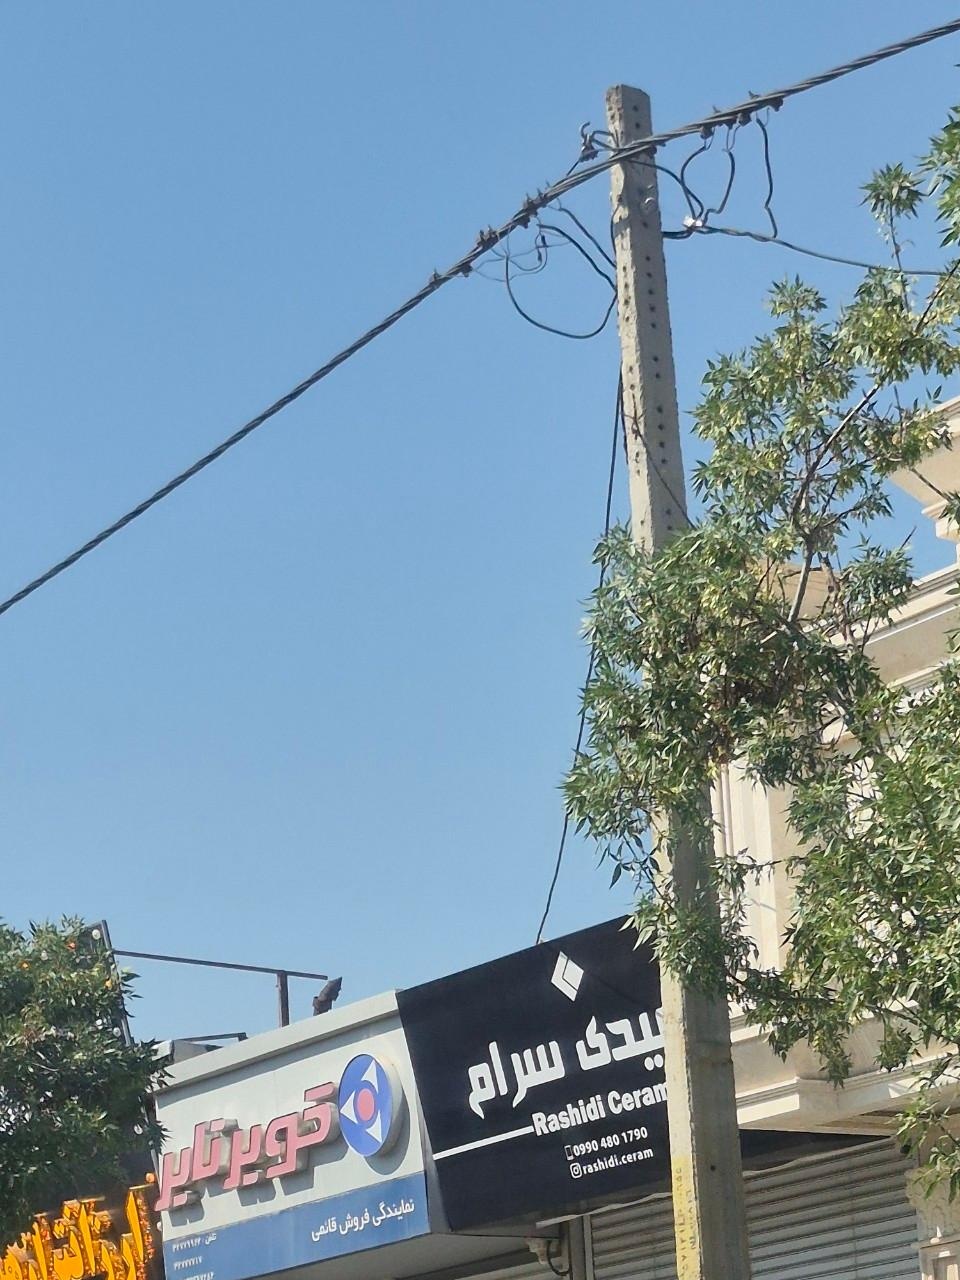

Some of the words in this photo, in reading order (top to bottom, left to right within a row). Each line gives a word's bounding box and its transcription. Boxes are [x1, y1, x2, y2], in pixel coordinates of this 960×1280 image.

[468, 1040, 565, 1120] سرام
[532, 1094, 606, 1136] Rashidi
[572, 1140, 599, 1157] 0990
[601, 1134, 620, 1150] 480
[621, 1126, 649, 1143] 1790
[582, 1148, 654, 1175] rashidi.ceram
[339, 1208, 370, 1235] فروش
[372, 1198, 415, 1227] نمایندگی
[311, 1216, 337, 1242] قائمی
